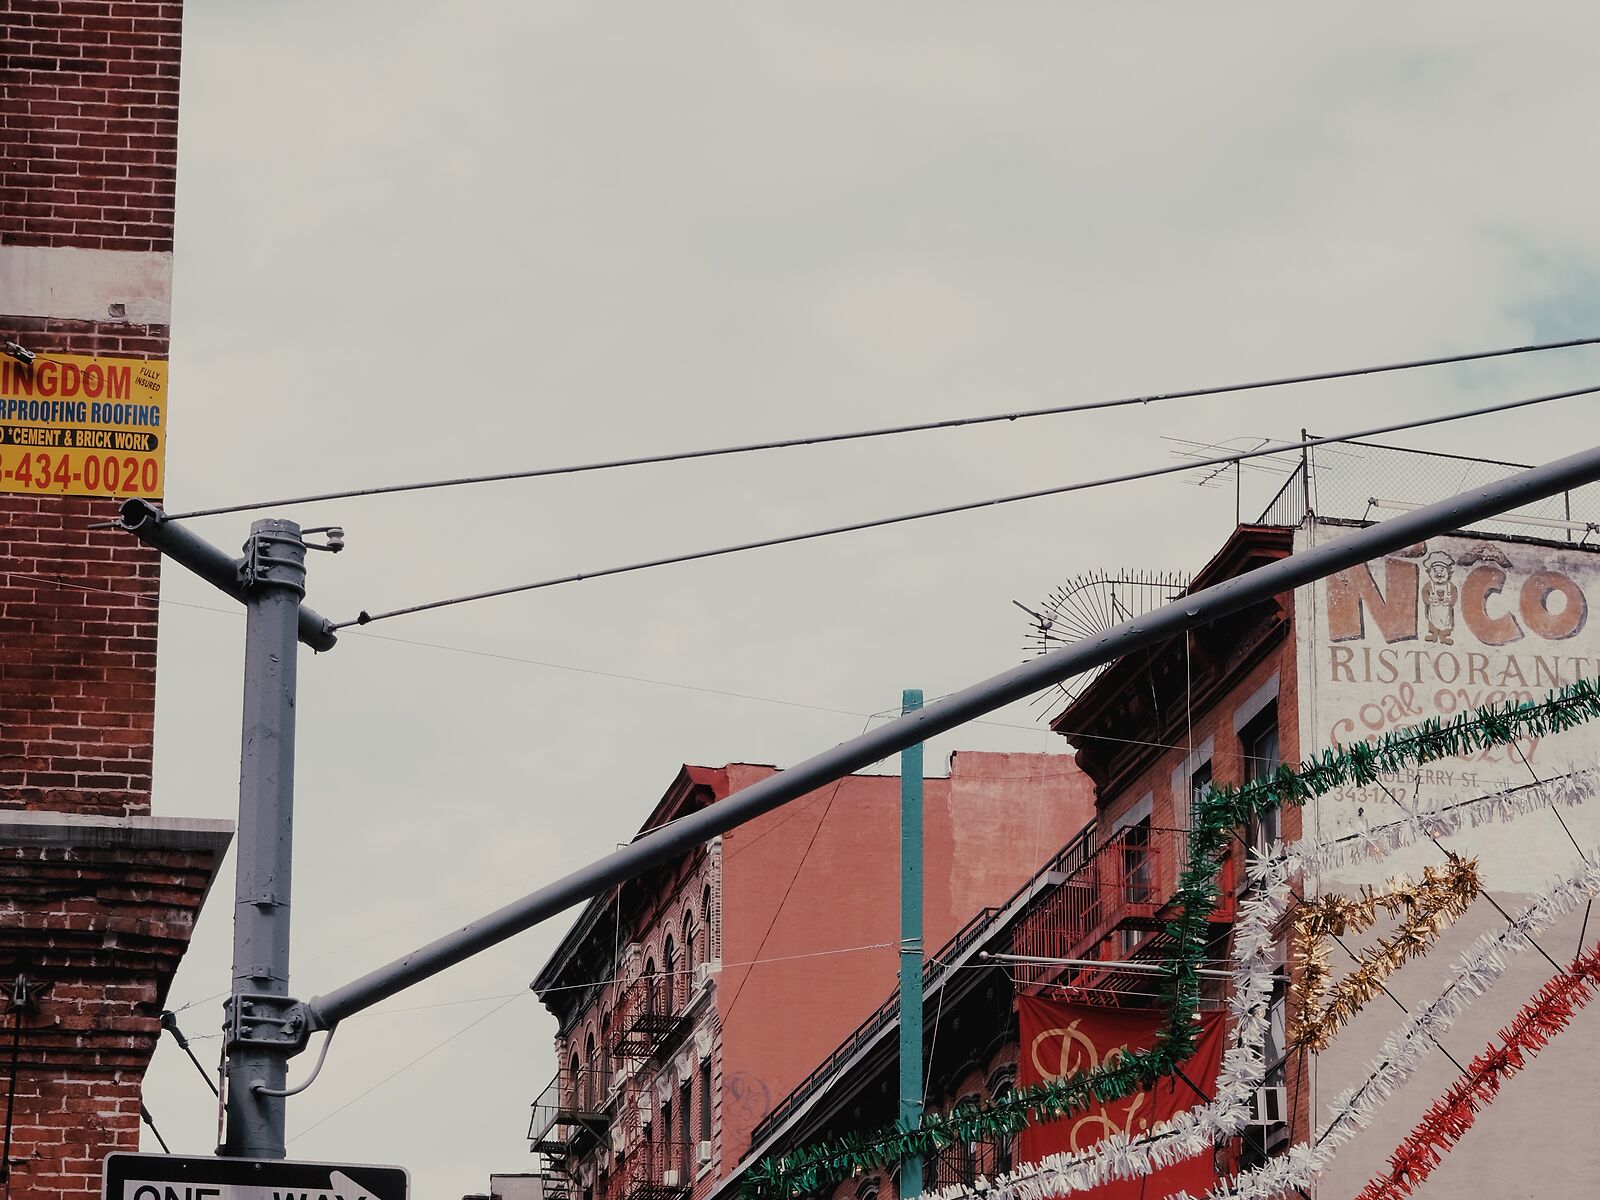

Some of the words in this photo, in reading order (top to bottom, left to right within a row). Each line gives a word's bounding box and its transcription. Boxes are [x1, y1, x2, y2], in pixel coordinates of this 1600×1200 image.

[139, 367, 161, 380] FULLY
[135, 376, 161, 392] INSURED
[91, 402, 160, 427] ROOFING
[64, 430, 72, 446] &
[76, 431, 112, 449] BRICK
[115, 433, 150, 450] WORK
[0, 452, 158, 493] -434-0020
[1328, 645, 1600, 688] RISTORANT
[1462, 772, 1480, 788] ST.
